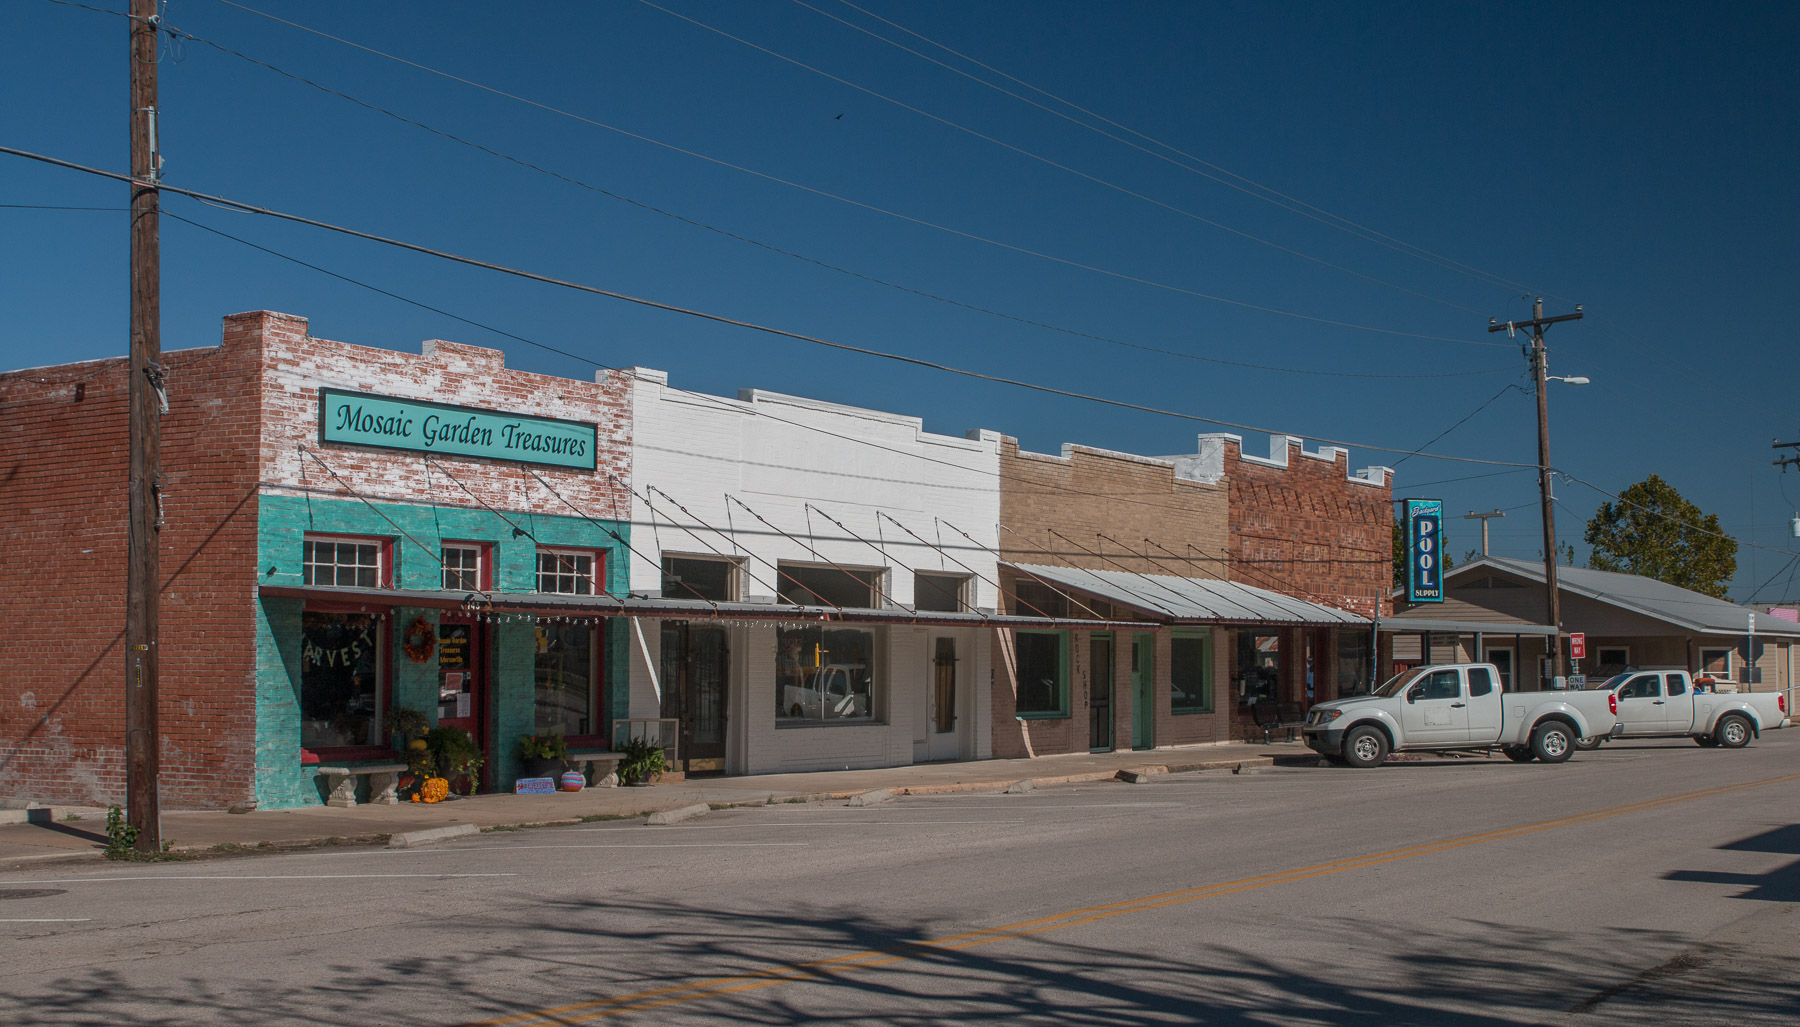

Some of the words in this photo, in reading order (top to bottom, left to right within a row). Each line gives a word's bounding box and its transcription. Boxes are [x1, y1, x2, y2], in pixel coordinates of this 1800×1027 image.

[336, 404, 413, 437] Mosaic
[422, 414, 493, 447] Garden
[501, 423, 586, 457] Treasures
[1411, 504, 1440, 517] Backyard
[1420, 521, 1433, 586] POOL
[1415, 589, 1439, 597] SUPPLY
[302, 629, 373, 668] ARVEST
[1572, 637, 1583, 645] WRONG
